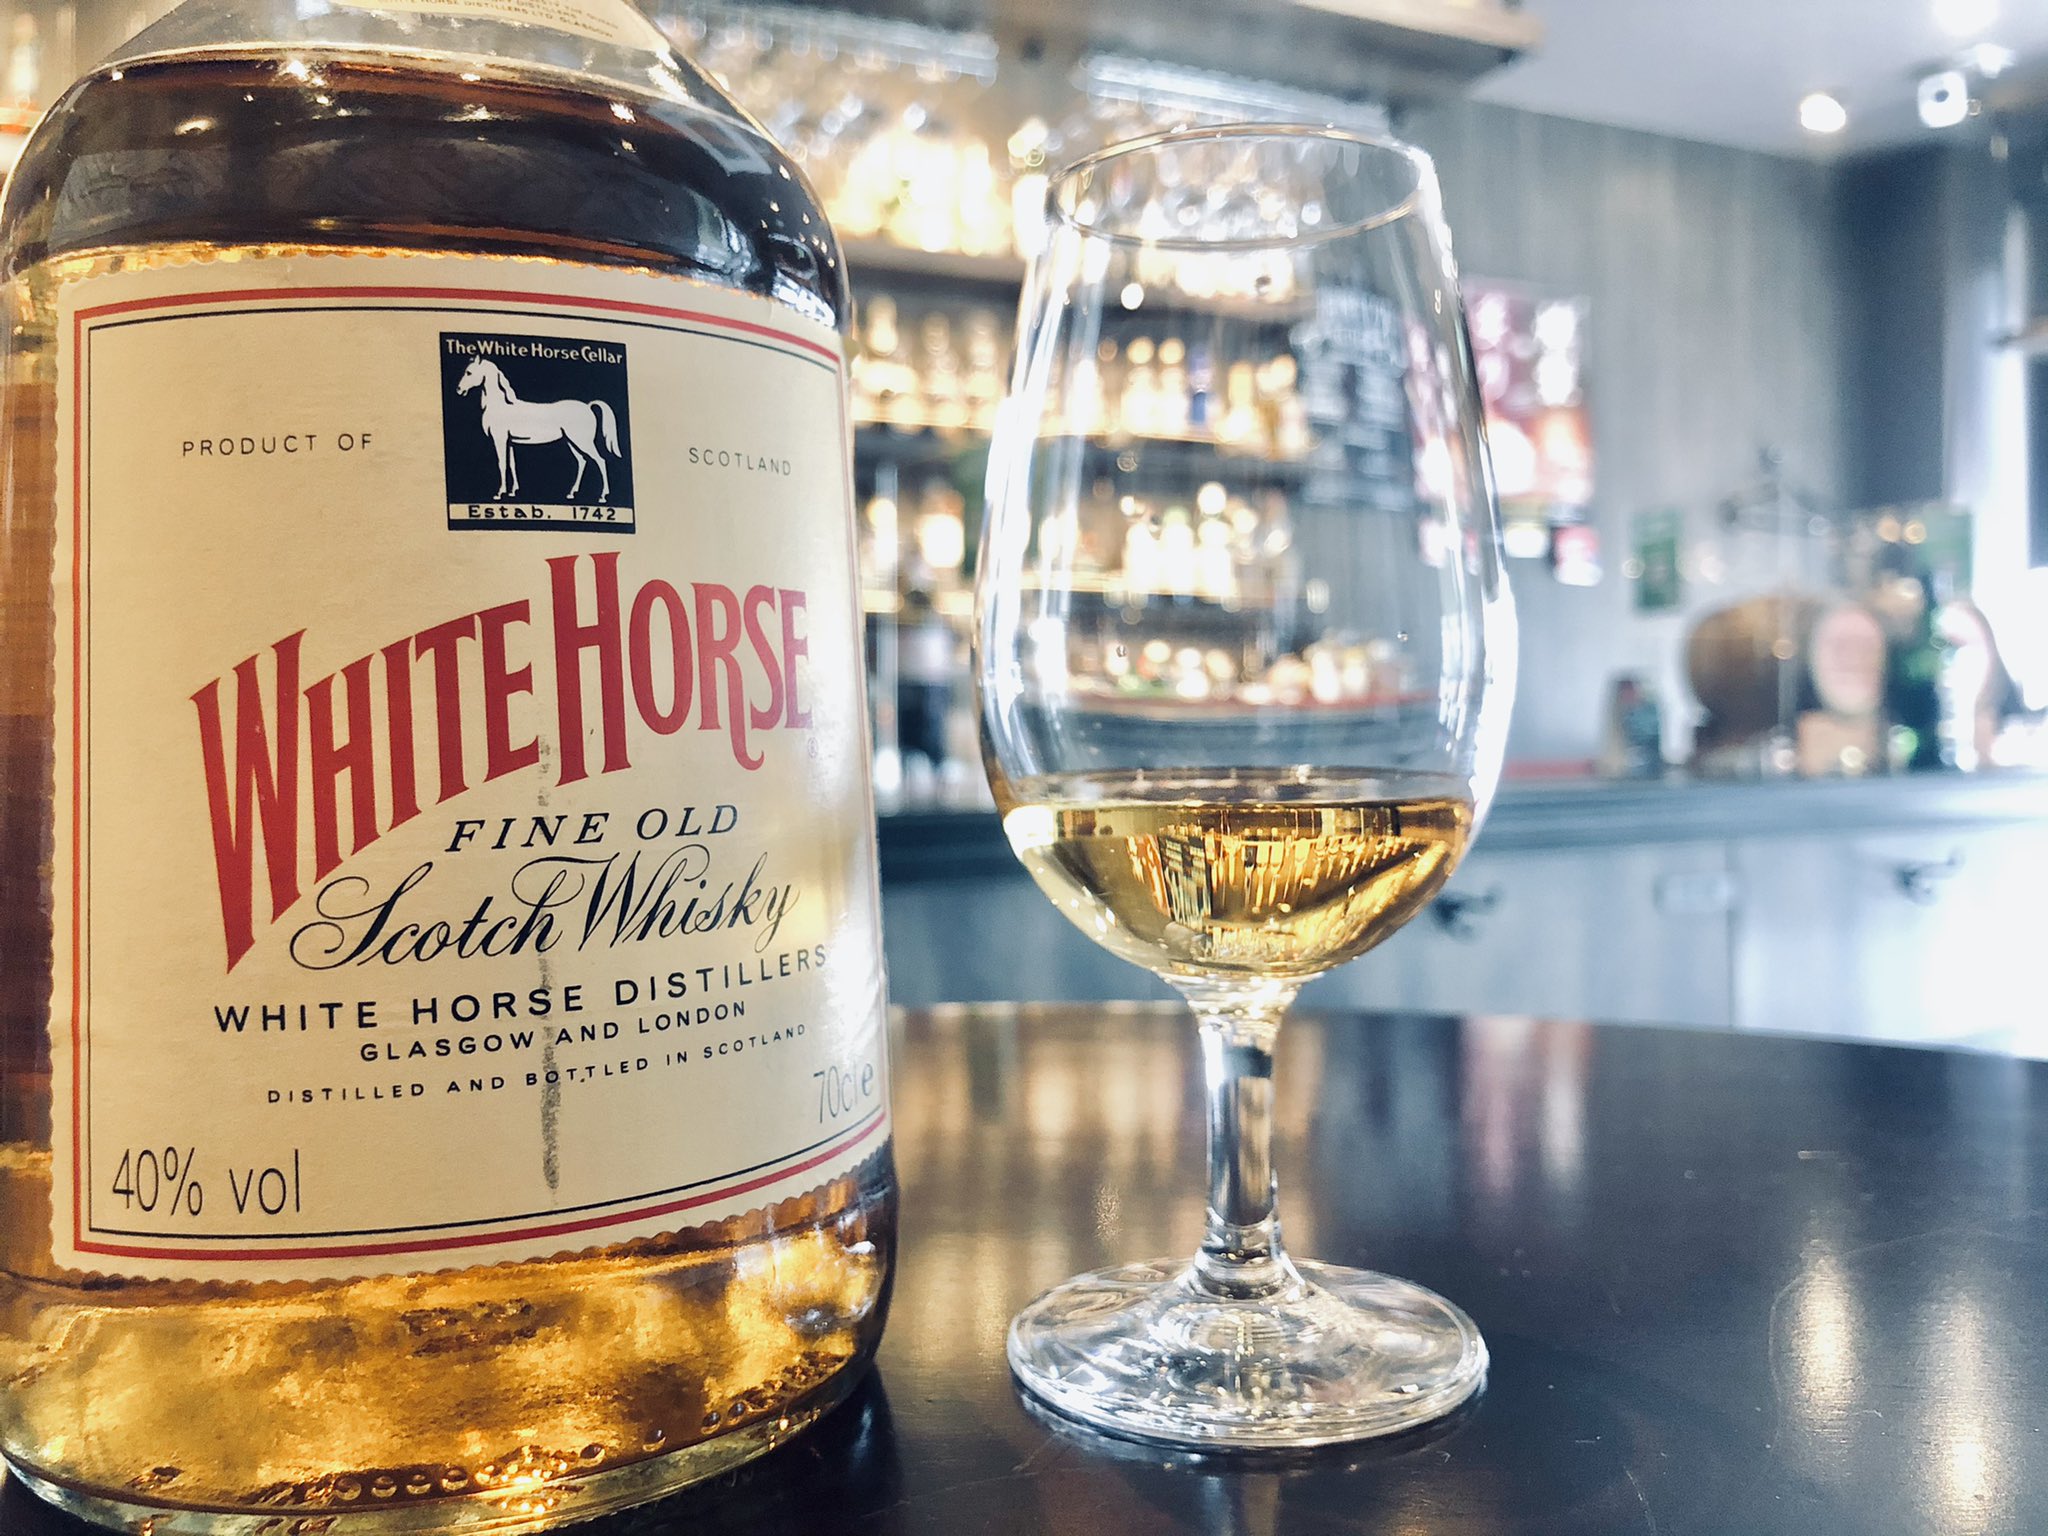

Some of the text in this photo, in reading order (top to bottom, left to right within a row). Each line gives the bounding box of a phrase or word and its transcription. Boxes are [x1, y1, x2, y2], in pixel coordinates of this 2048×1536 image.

[446, 339, 623, 364] The White Horse Cellar
[182, 433, 372, 457] PRODUCT OF
[688, 447, 792, 476] SCOTLAND
[468, 505, 617, 521] Estab. 1742
[190, 551, 814, 975] WHITE HORSE
[444, 803, 740, 853] FINE OLD
[289, 843, 801, 971] Scotch Whisky
[214, 944, 827, 1033] WHITE HORSE DISTILLERS
[360, 1001, 745, 1062] GLASGOW AND LONDON
[268, 1023, 806, 1103] DISTILLED AND BOTTLED IN SCOTLAND
[112, 1146, 300, 1217] 40% vol
